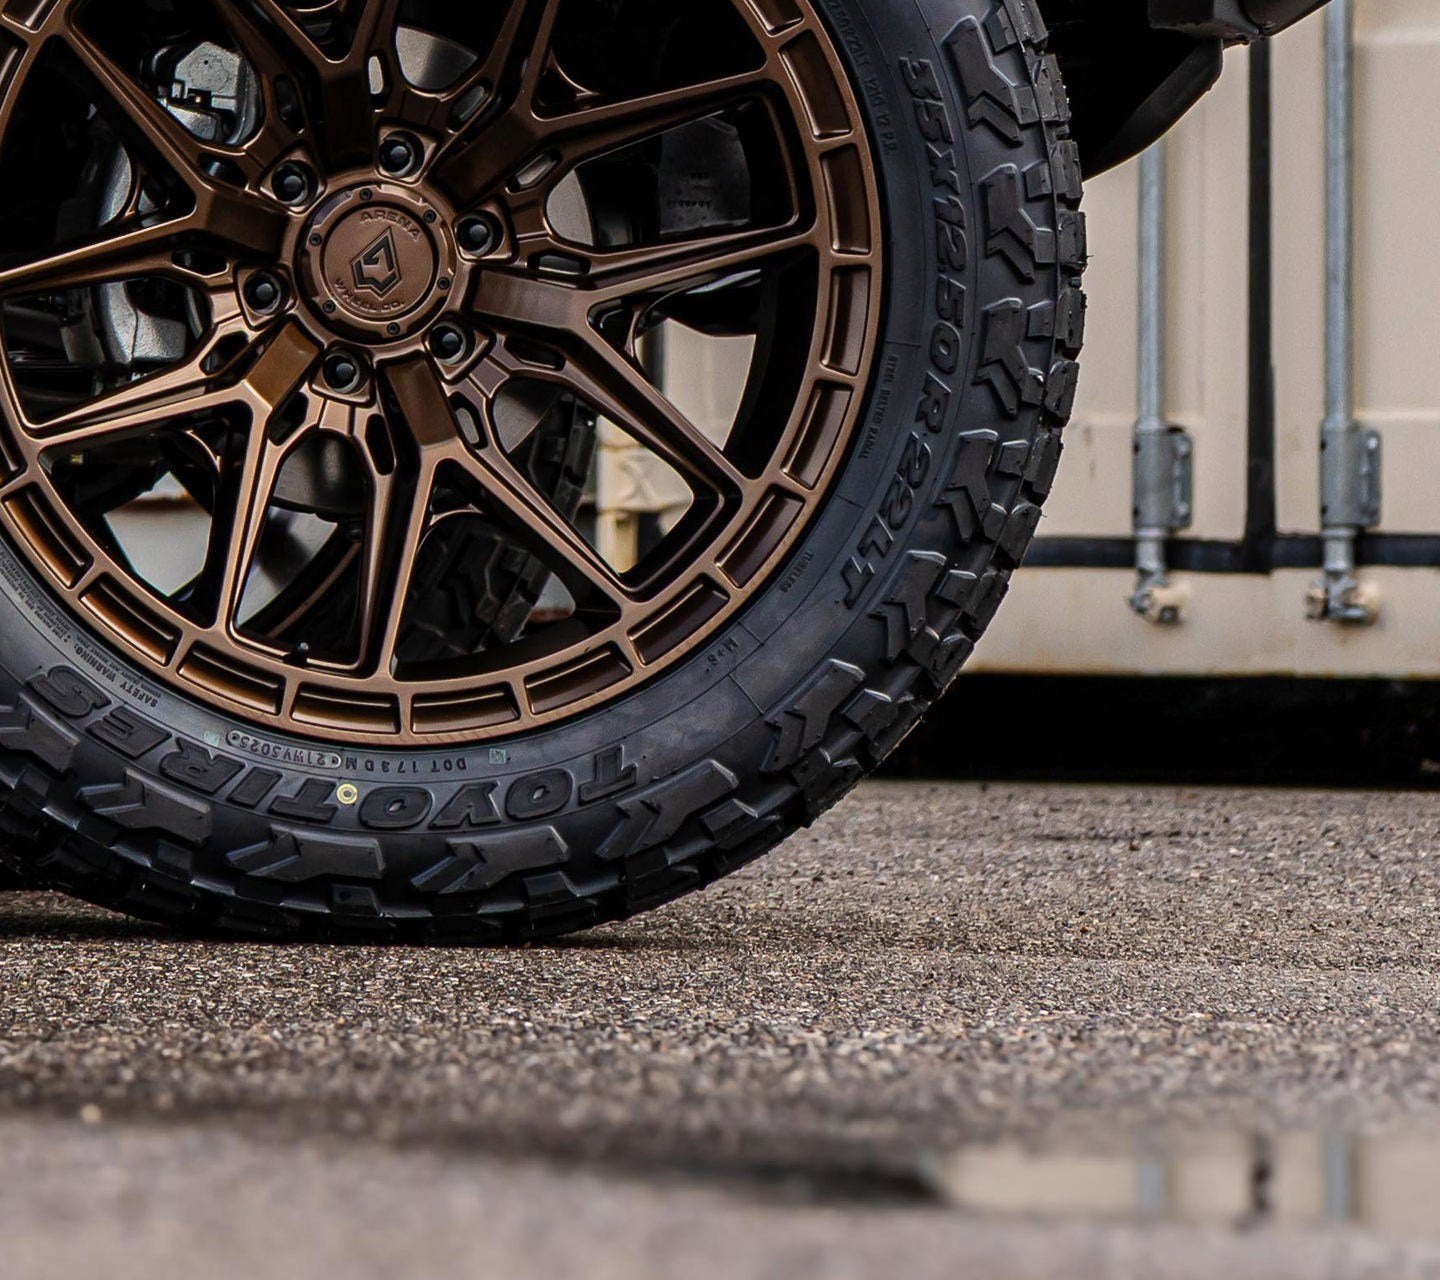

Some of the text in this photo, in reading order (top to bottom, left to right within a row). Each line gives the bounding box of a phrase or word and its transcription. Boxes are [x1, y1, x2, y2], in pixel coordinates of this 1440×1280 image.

[360, 209, 420, 242] ARENA
[882, 354, 898, 385] STEEL
[856, 425, 879, 462] RADIAL
[778, 550, 815, 594] TUBELESS
[118, 678, 159, 709] SAFETY
[28, 662, 339, 828] TIRES
[429, 756, 468, 773] DOT
[356, 743, 641, 836] TOYO
